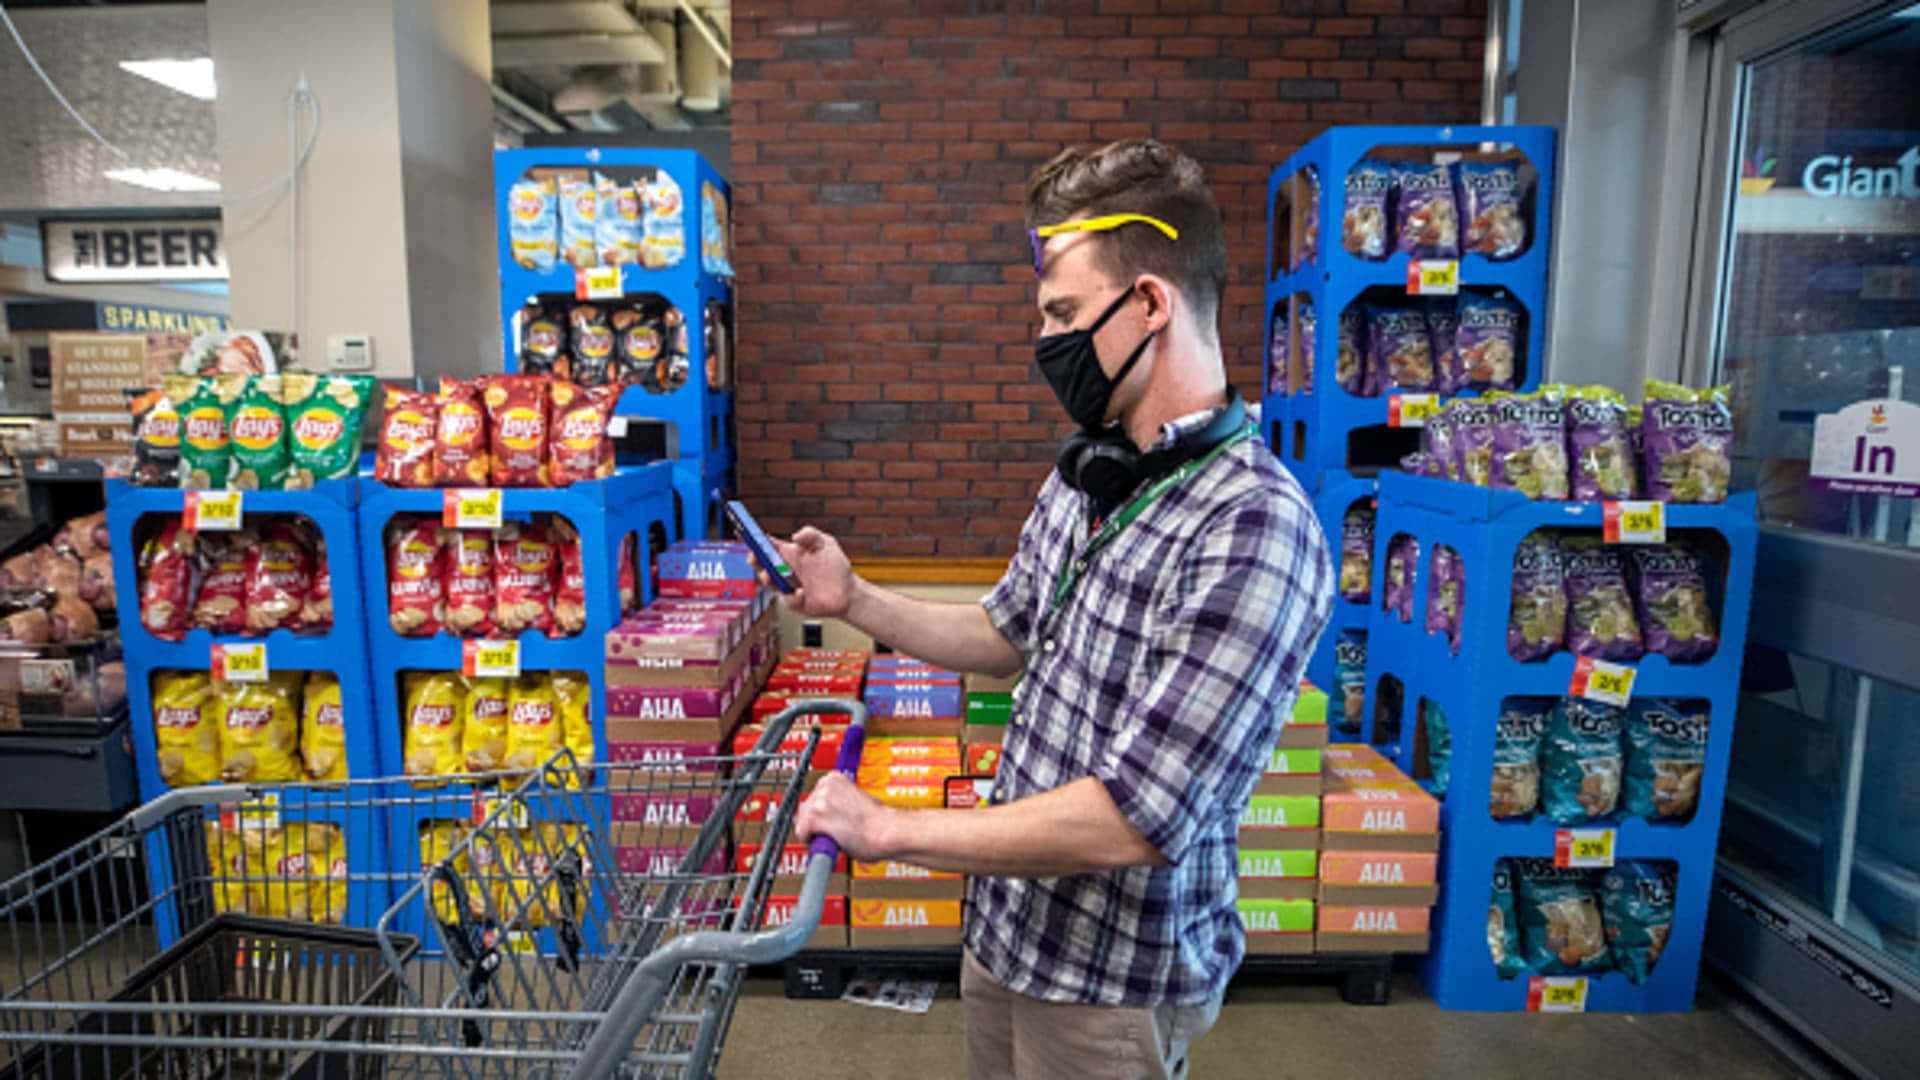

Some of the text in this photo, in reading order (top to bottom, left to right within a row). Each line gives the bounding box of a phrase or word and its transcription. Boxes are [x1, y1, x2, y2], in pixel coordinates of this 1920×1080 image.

[104, 229, 218, 267] BEER
[1853, 436, 1896, 475] In
[686, 561, 726, 580] AHA
[639, 697, 686, 719] AHA
[892, 699, 933, 718] AHA
[642, 750, 687, 772] AHA
[644, 804, 690, 825] AHA
[1360, 810, 1407, 831] AHA
[1239, 857, 1285, 877] AHA
[1359, 862, 1405, 883] AHA
[883, 906, 929, 926] AHA
[1352, 911, 1398, 931] AHA
